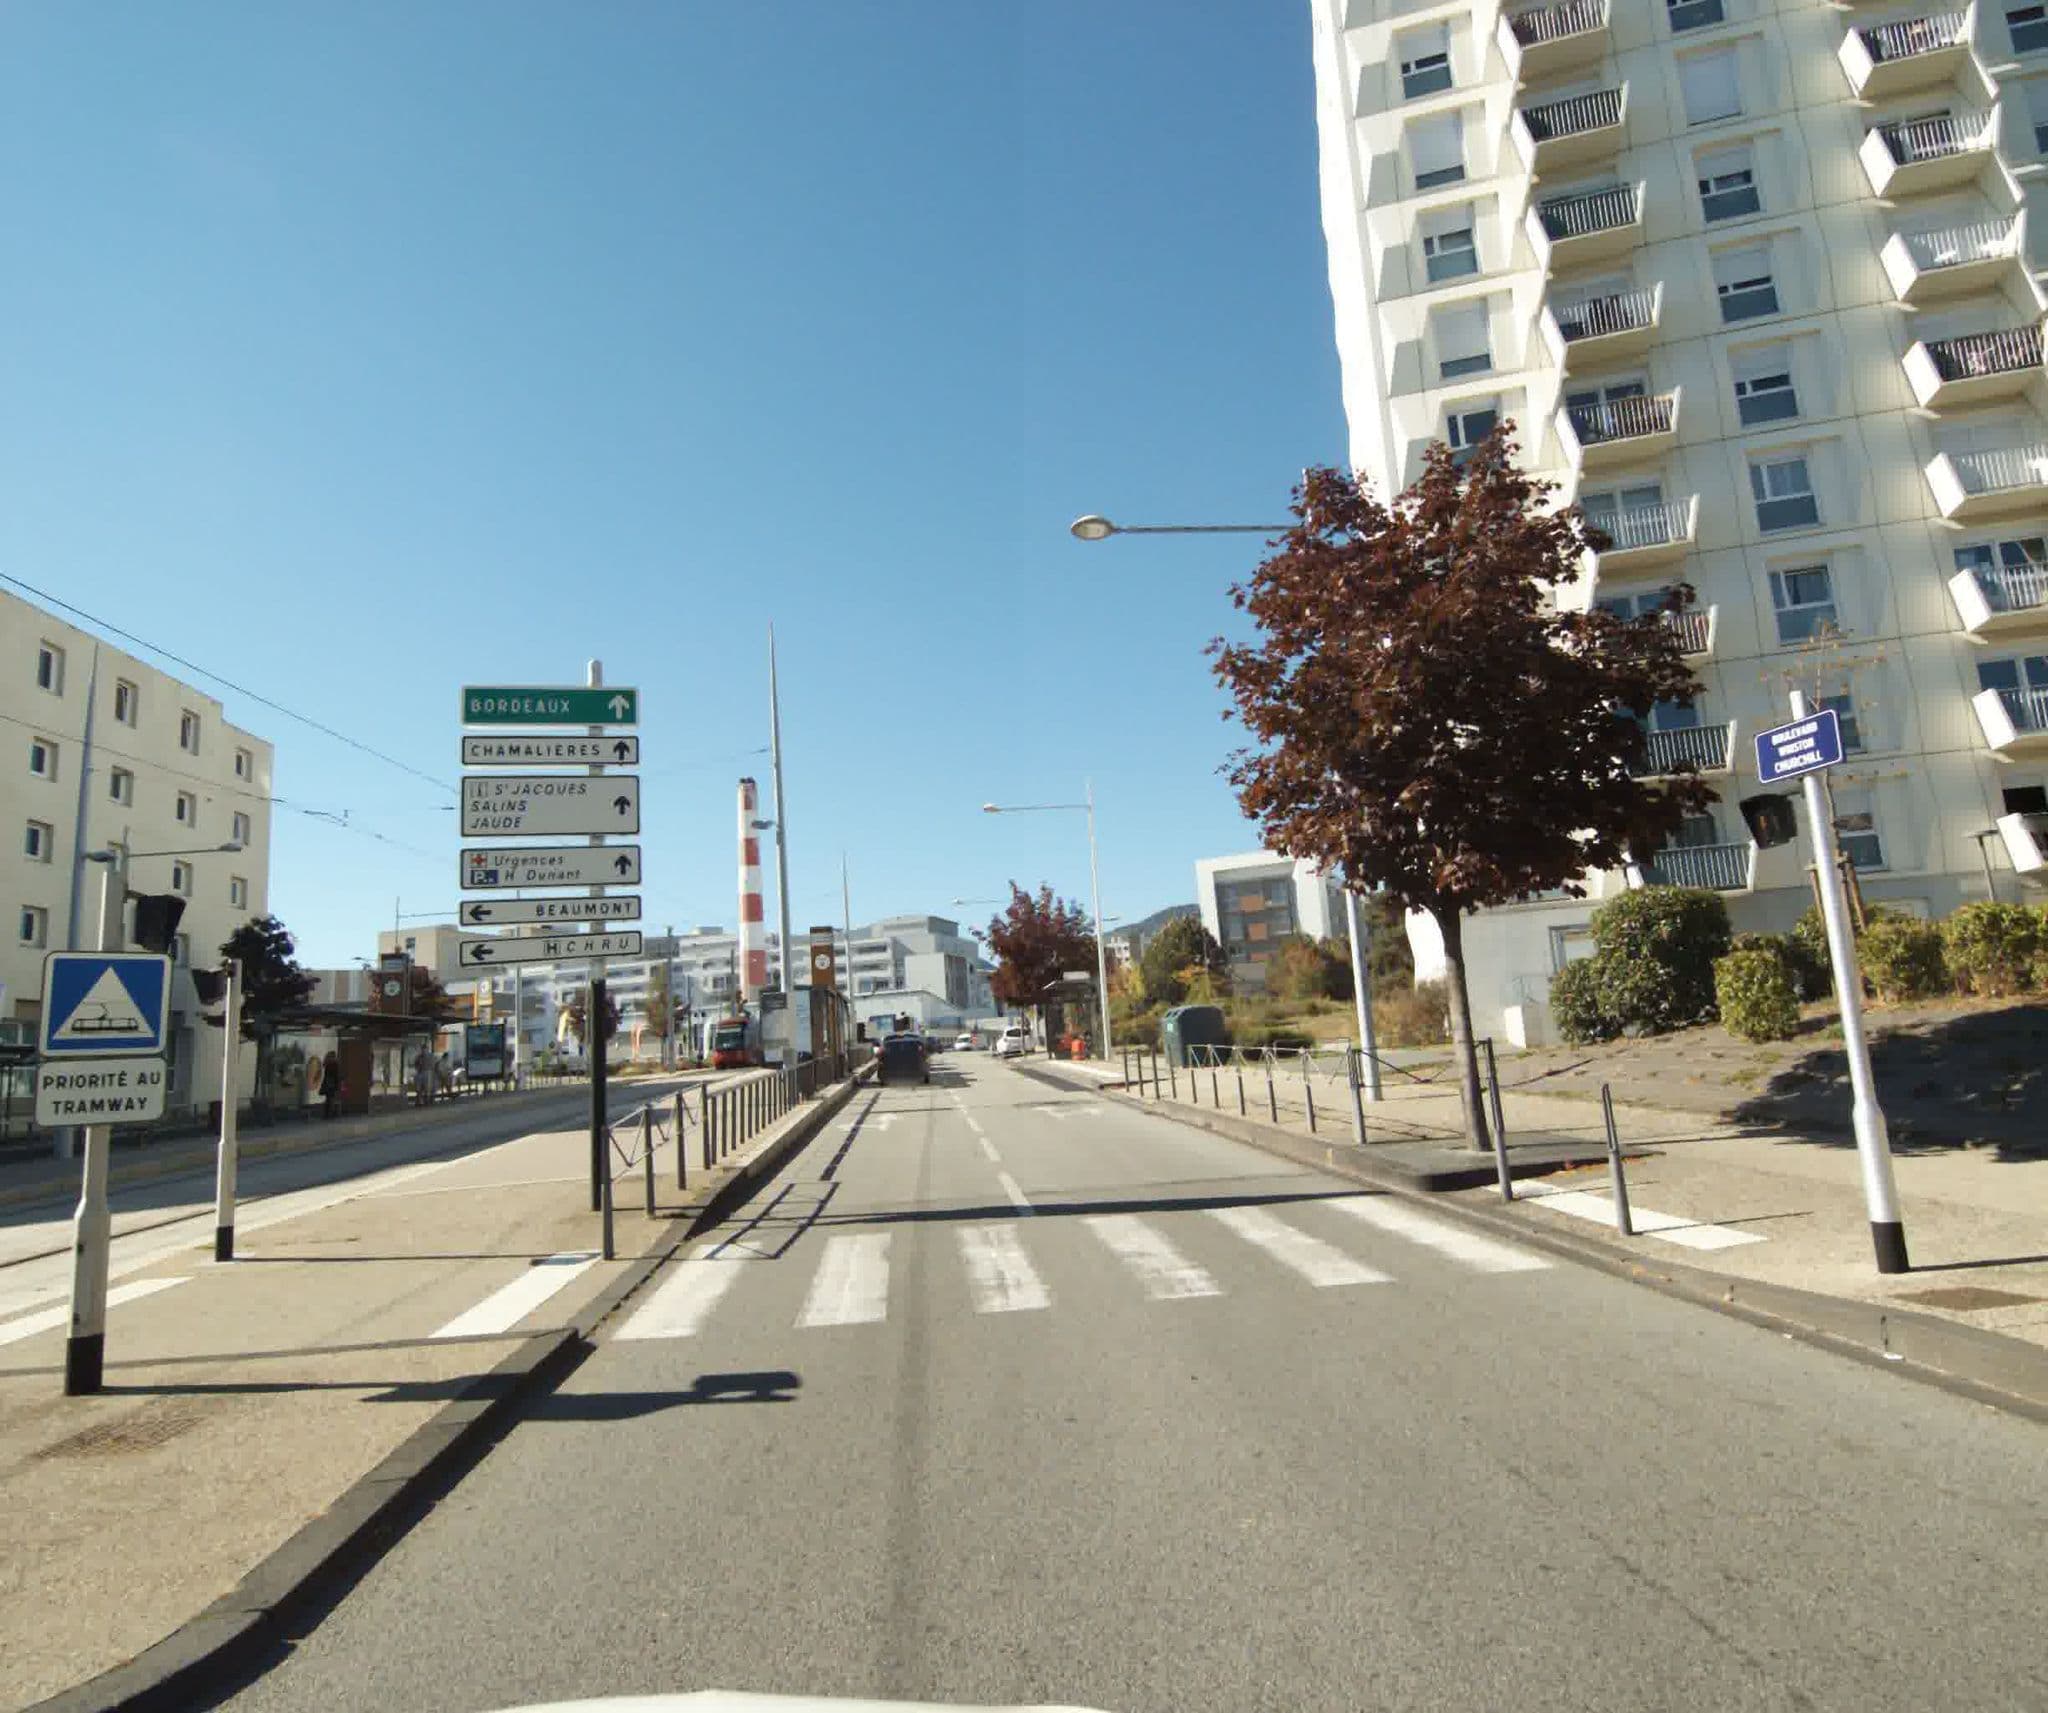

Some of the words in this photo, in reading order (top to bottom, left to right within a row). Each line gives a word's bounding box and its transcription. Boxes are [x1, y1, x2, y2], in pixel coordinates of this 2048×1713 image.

[470, 697, 570, 713] BORDEAUX
[471, 744, 601, 757] CHAMALIERES
[512, 783, 588, 796] JACQUES
[471, 800, 528, 812] SALINS
[471, 816, 522, 829] JAUDE
[494, 855, 564, 870] Urgences
[526, 869, 582, 881] Dunant
[536, 903, 632, 916] BEAUMONT
[42, 1070, 128, 1090] PRIORITÉ
[137, 1070, 161, 1085] AU
[52, 1097, 148, 1115] TRAMWAY
